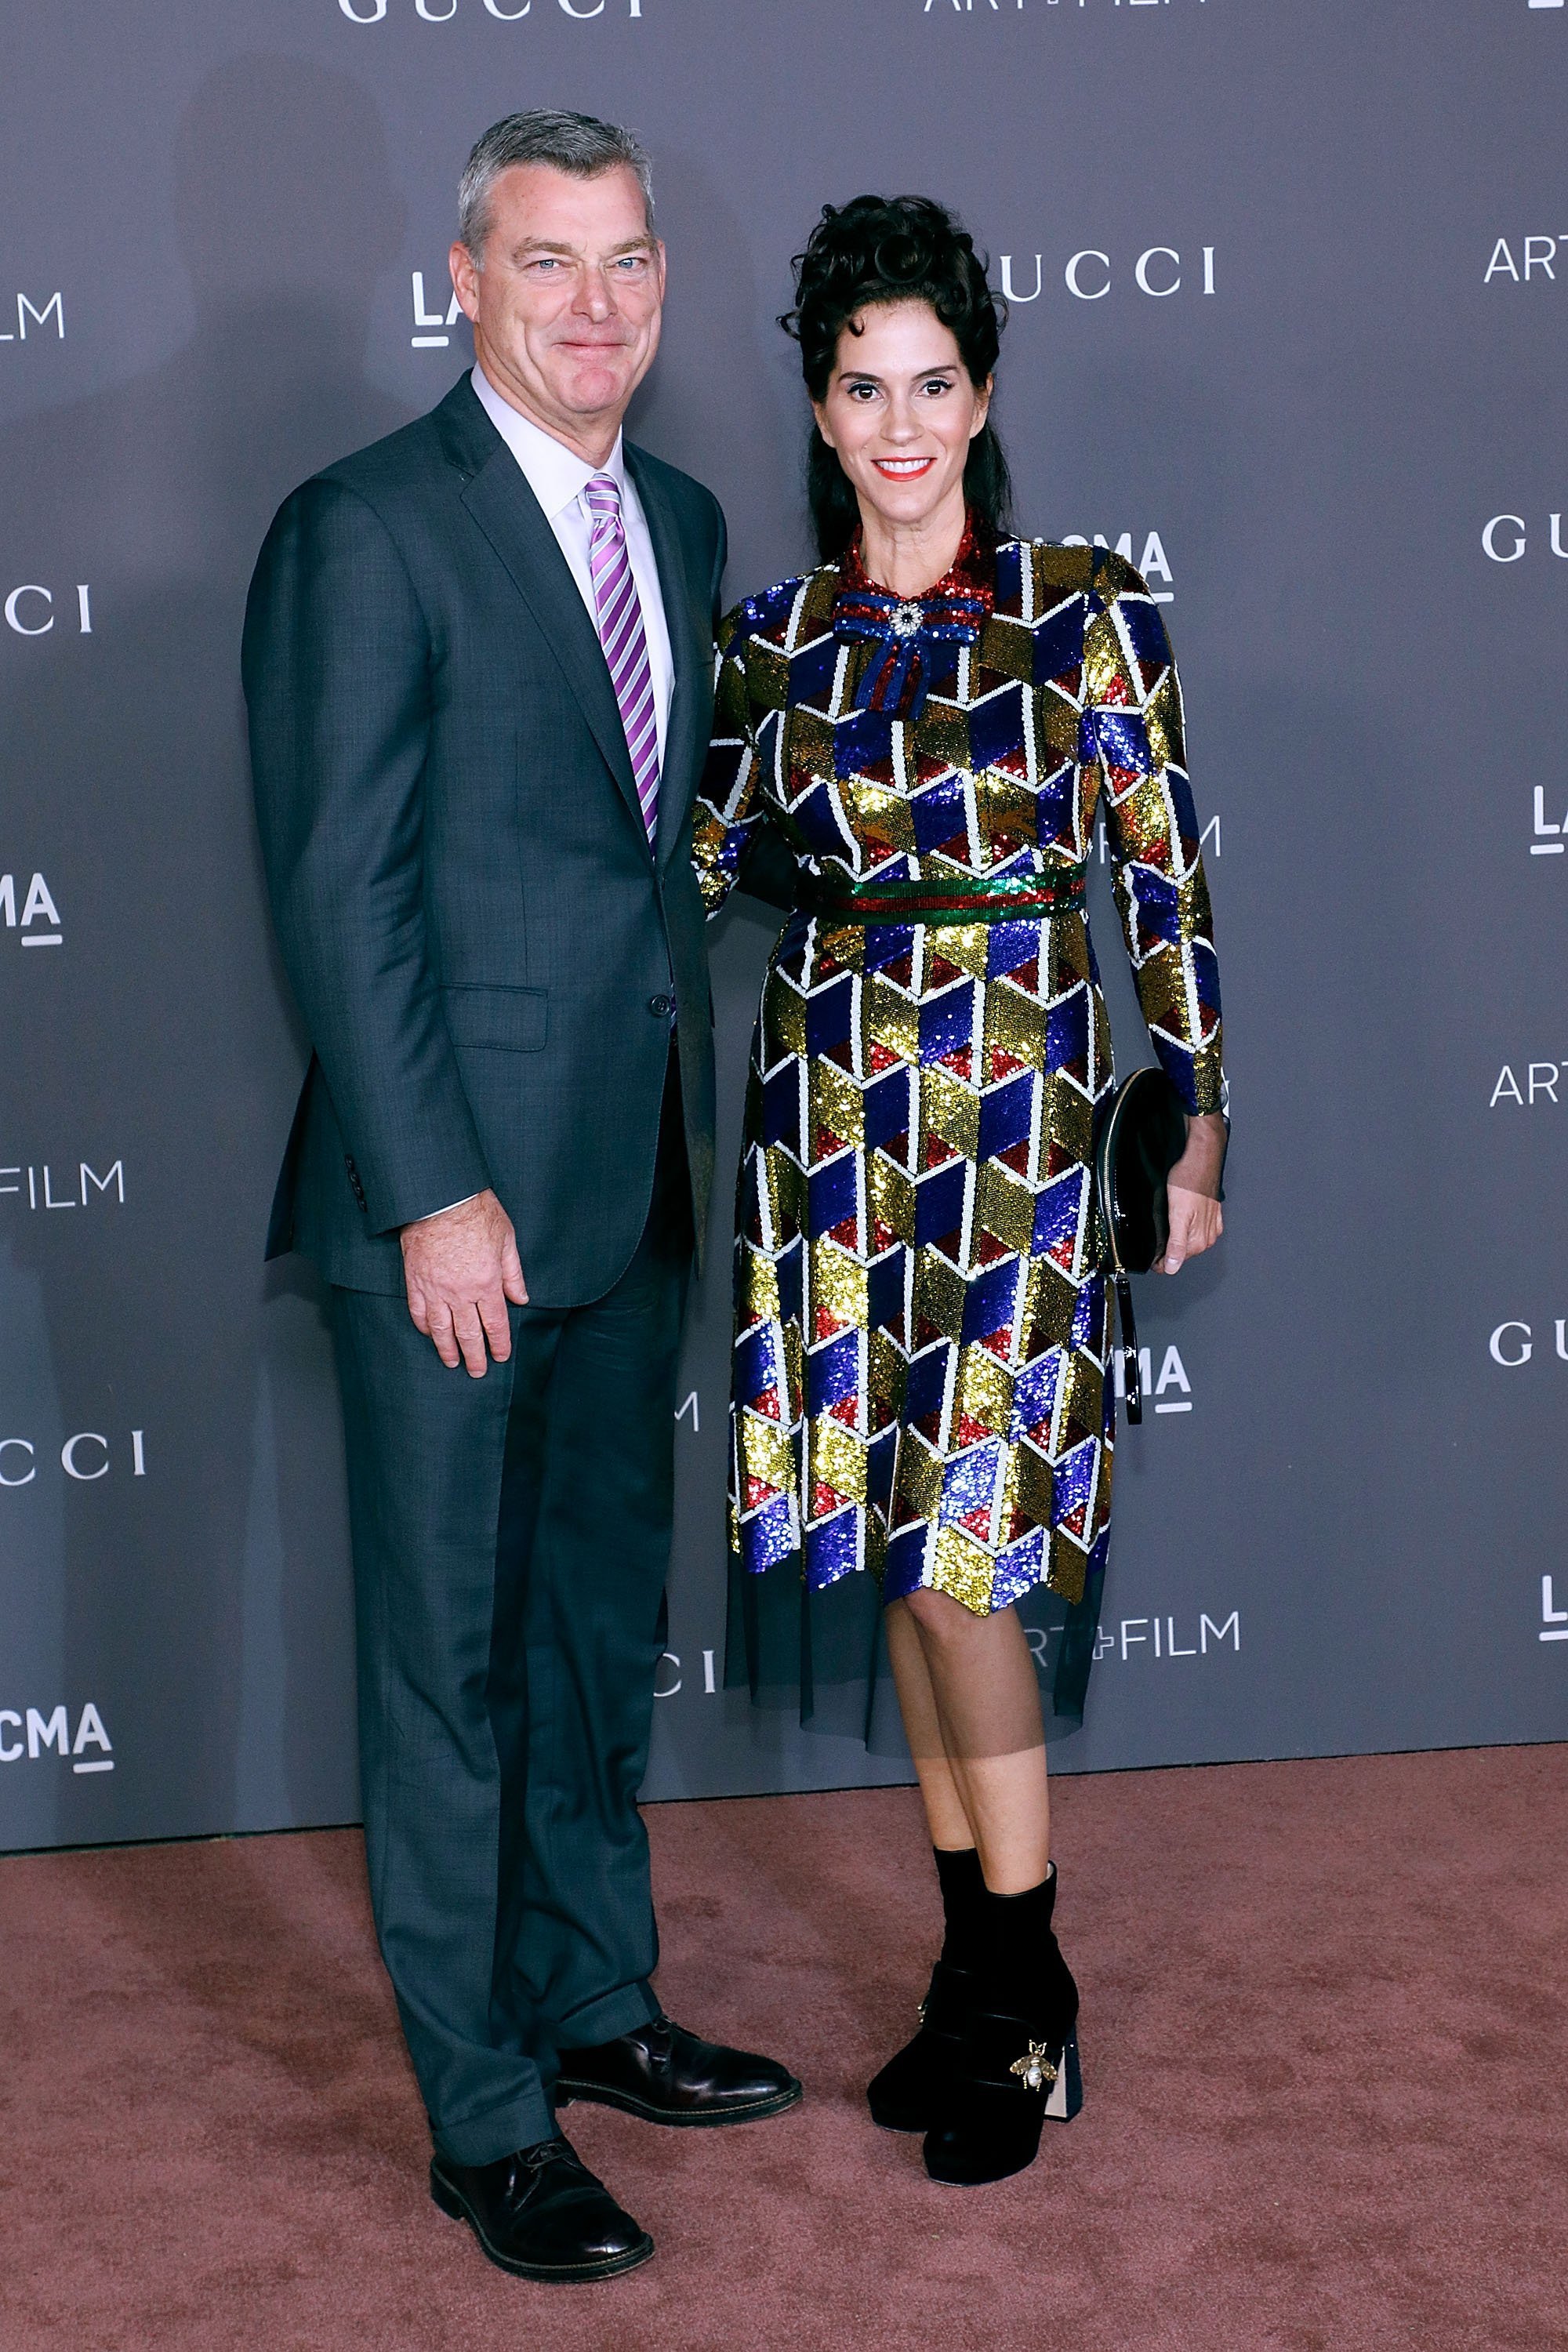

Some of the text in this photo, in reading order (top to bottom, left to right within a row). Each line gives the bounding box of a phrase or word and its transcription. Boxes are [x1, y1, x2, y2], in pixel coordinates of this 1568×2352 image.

[1000, 247, 1215, 303] UCCI
[1484, 235, 1568, 282] AR
[0, 292, 64, 340] M
[5, 585, 93, 635] CI
[1534, 786, 1568, 836] L
[1490, 1062, 1568, 1107] AR
